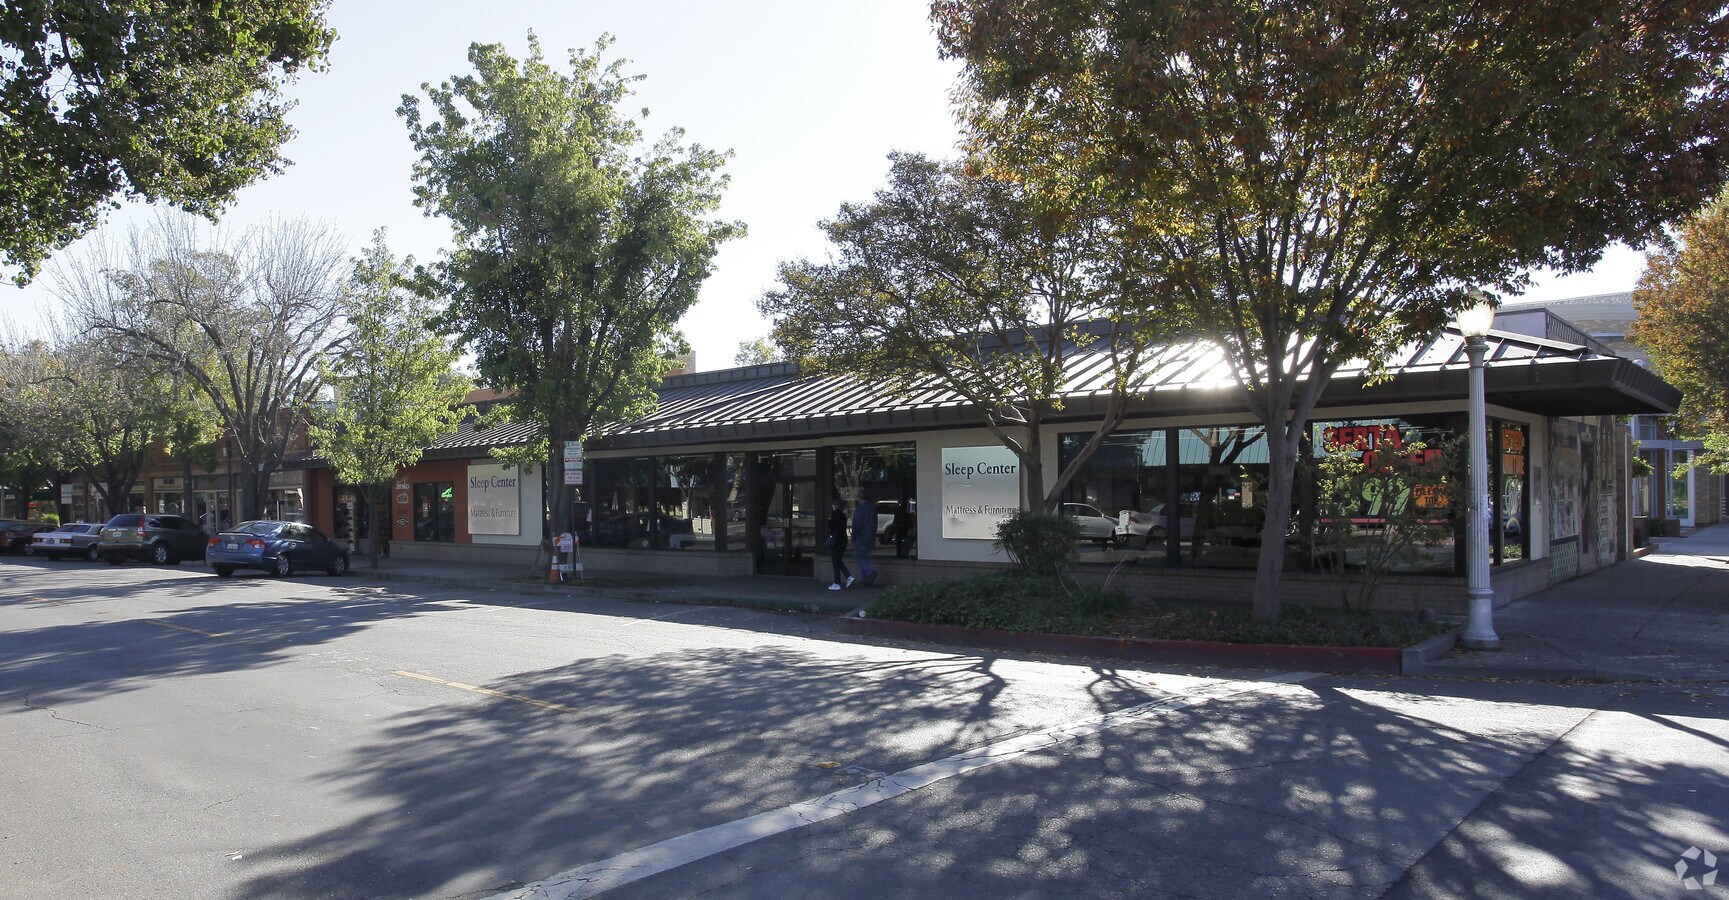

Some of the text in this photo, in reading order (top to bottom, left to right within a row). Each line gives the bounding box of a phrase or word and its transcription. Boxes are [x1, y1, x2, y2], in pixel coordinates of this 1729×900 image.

[945, 462, 1016, 479] Sleep Center
[470, 475, 516, 493] Sleep Center
[470, 507, 517, 518] Mattress & Furniture
[945, 505, 1017, 515] Mattress & Furniture
